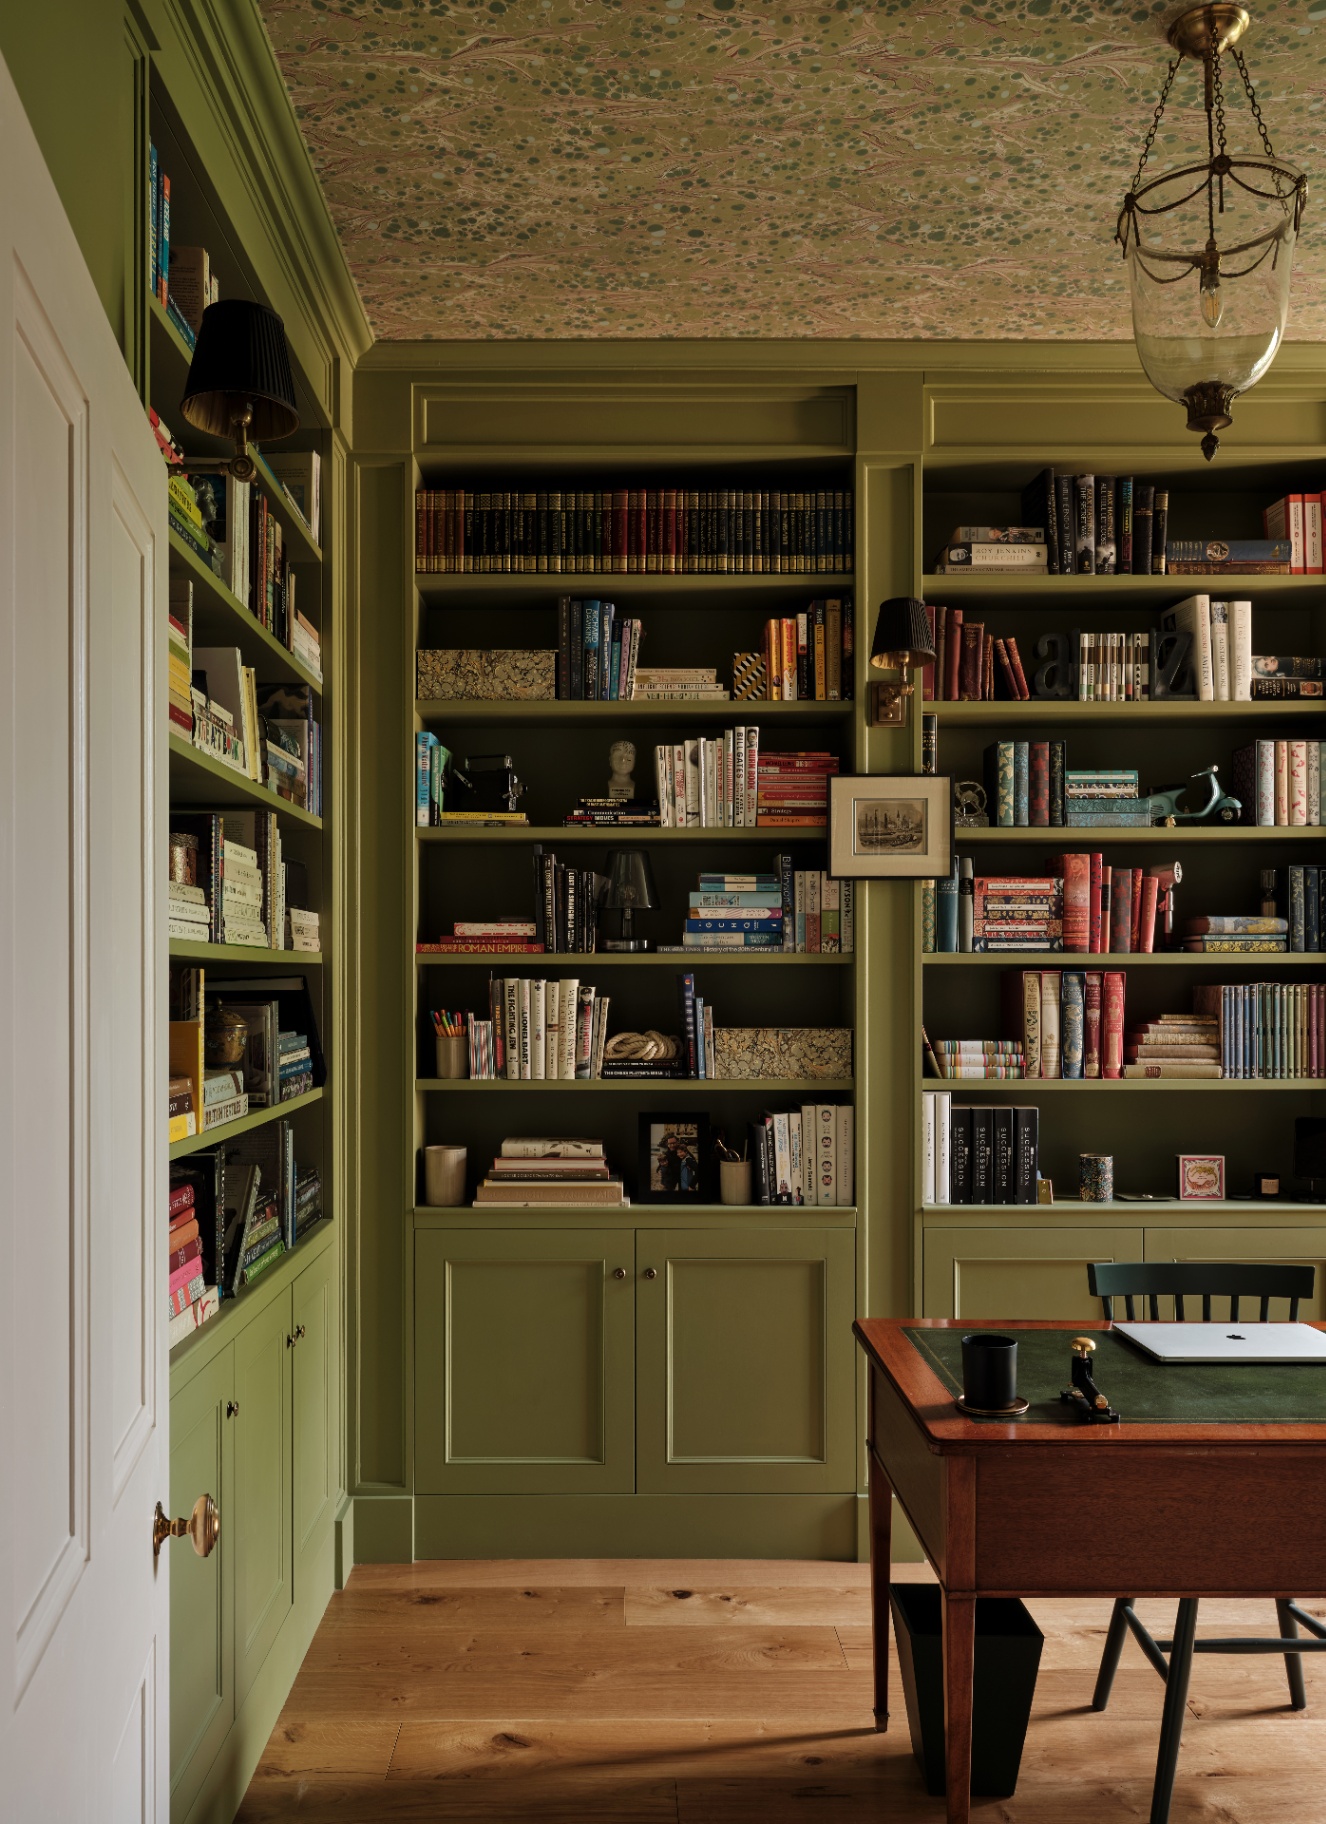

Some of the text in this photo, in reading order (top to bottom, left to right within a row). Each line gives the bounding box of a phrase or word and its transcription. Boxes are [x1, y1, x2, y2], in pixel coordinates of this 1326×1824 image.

[1201, 655, 1209, 687] AMERICA
[197, 715, 209, 745] THE
[211, 723, 221, 752] ART
[421, 736, 429, 748] What
[748, 749, 756, 790] BURN BOOK
[782, 871, 791, 902] Bryson
[458, 943, 495, 953] ROMAN
[497, 943, 528, 953] EMPIRE
[703, 946, 722, 954] History
[507, 984, 517, 1050] THE FIGHTING JEW
